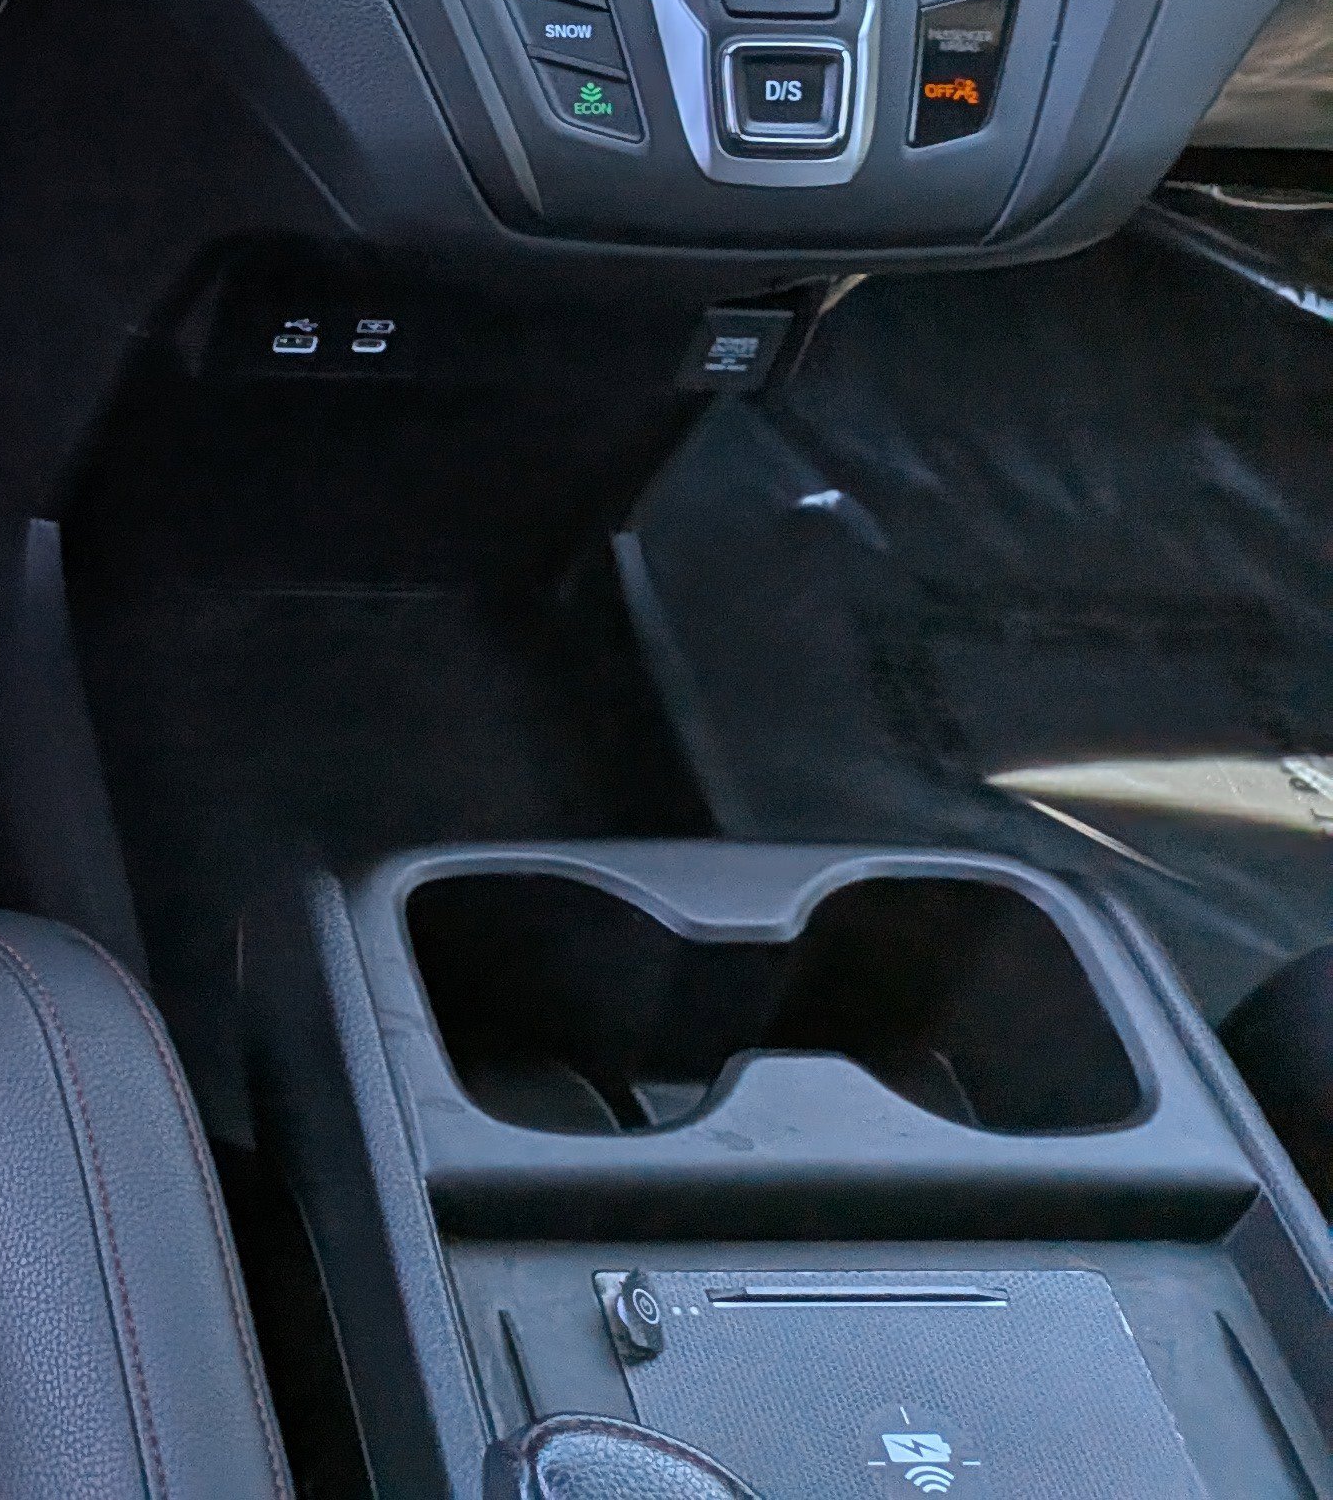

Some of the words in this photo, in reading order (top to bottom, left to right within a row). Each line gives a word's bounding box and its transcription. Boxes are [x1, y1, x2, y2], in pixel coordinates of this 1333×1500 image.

[544, 24, 593, 39] SNOW
[764, 79, 803, 103] D/S
[924, 83, 954, 98] OFF
[573, 102, 613, 115] ECON
